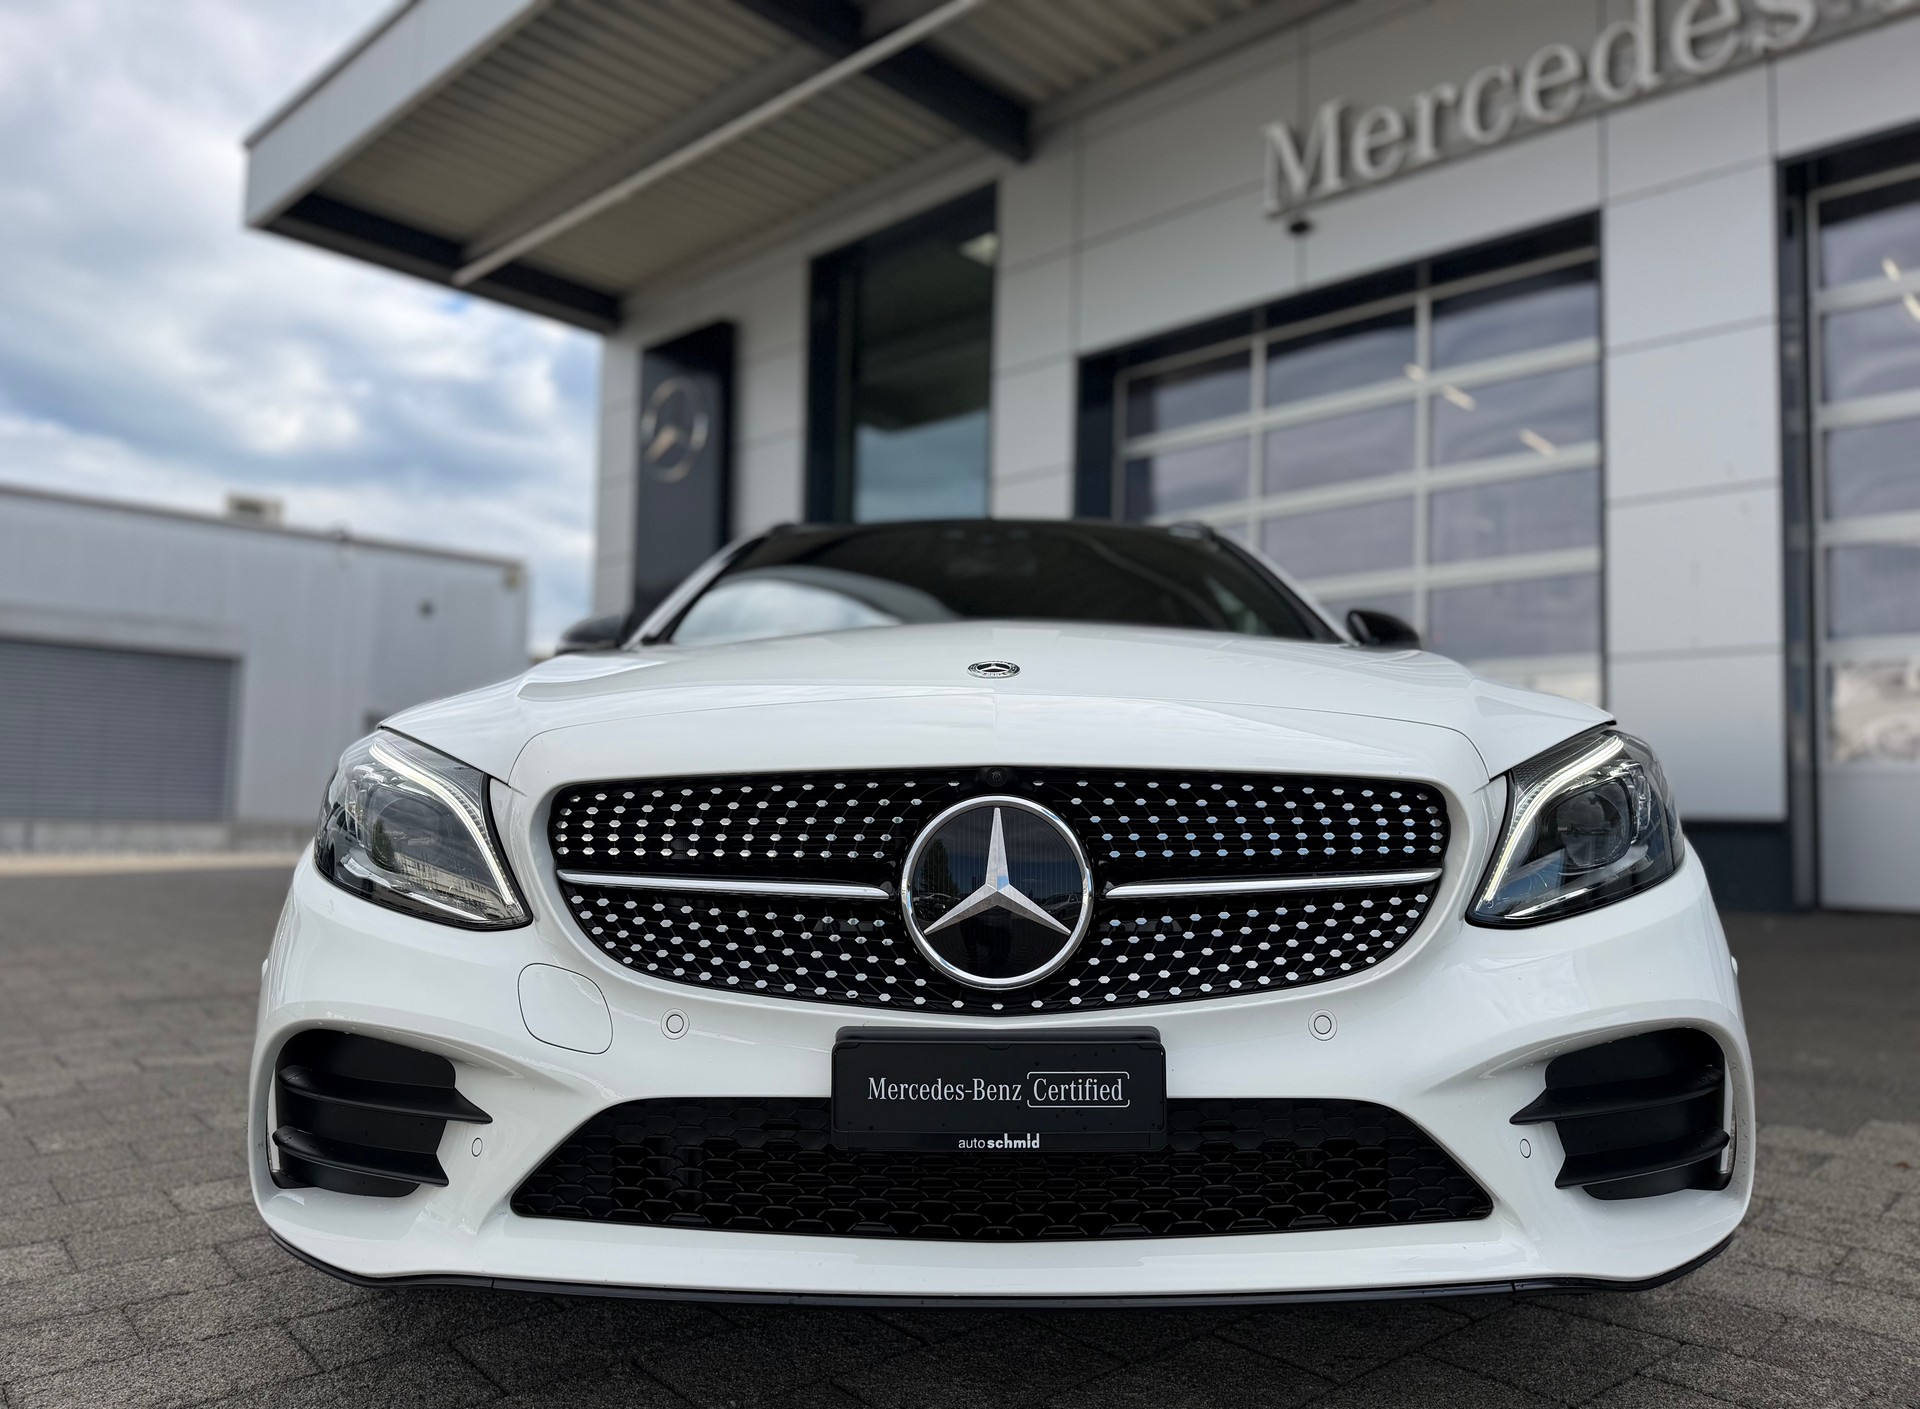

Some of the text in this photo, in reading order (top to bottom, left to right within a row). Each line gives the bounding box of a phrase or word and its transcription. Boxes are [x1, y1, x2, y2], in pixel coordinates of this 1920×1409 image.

[1264, 0, 1914, 217] Mercedes
[868, 1077, 1123, 1101] Mercedes-Benz Certified
